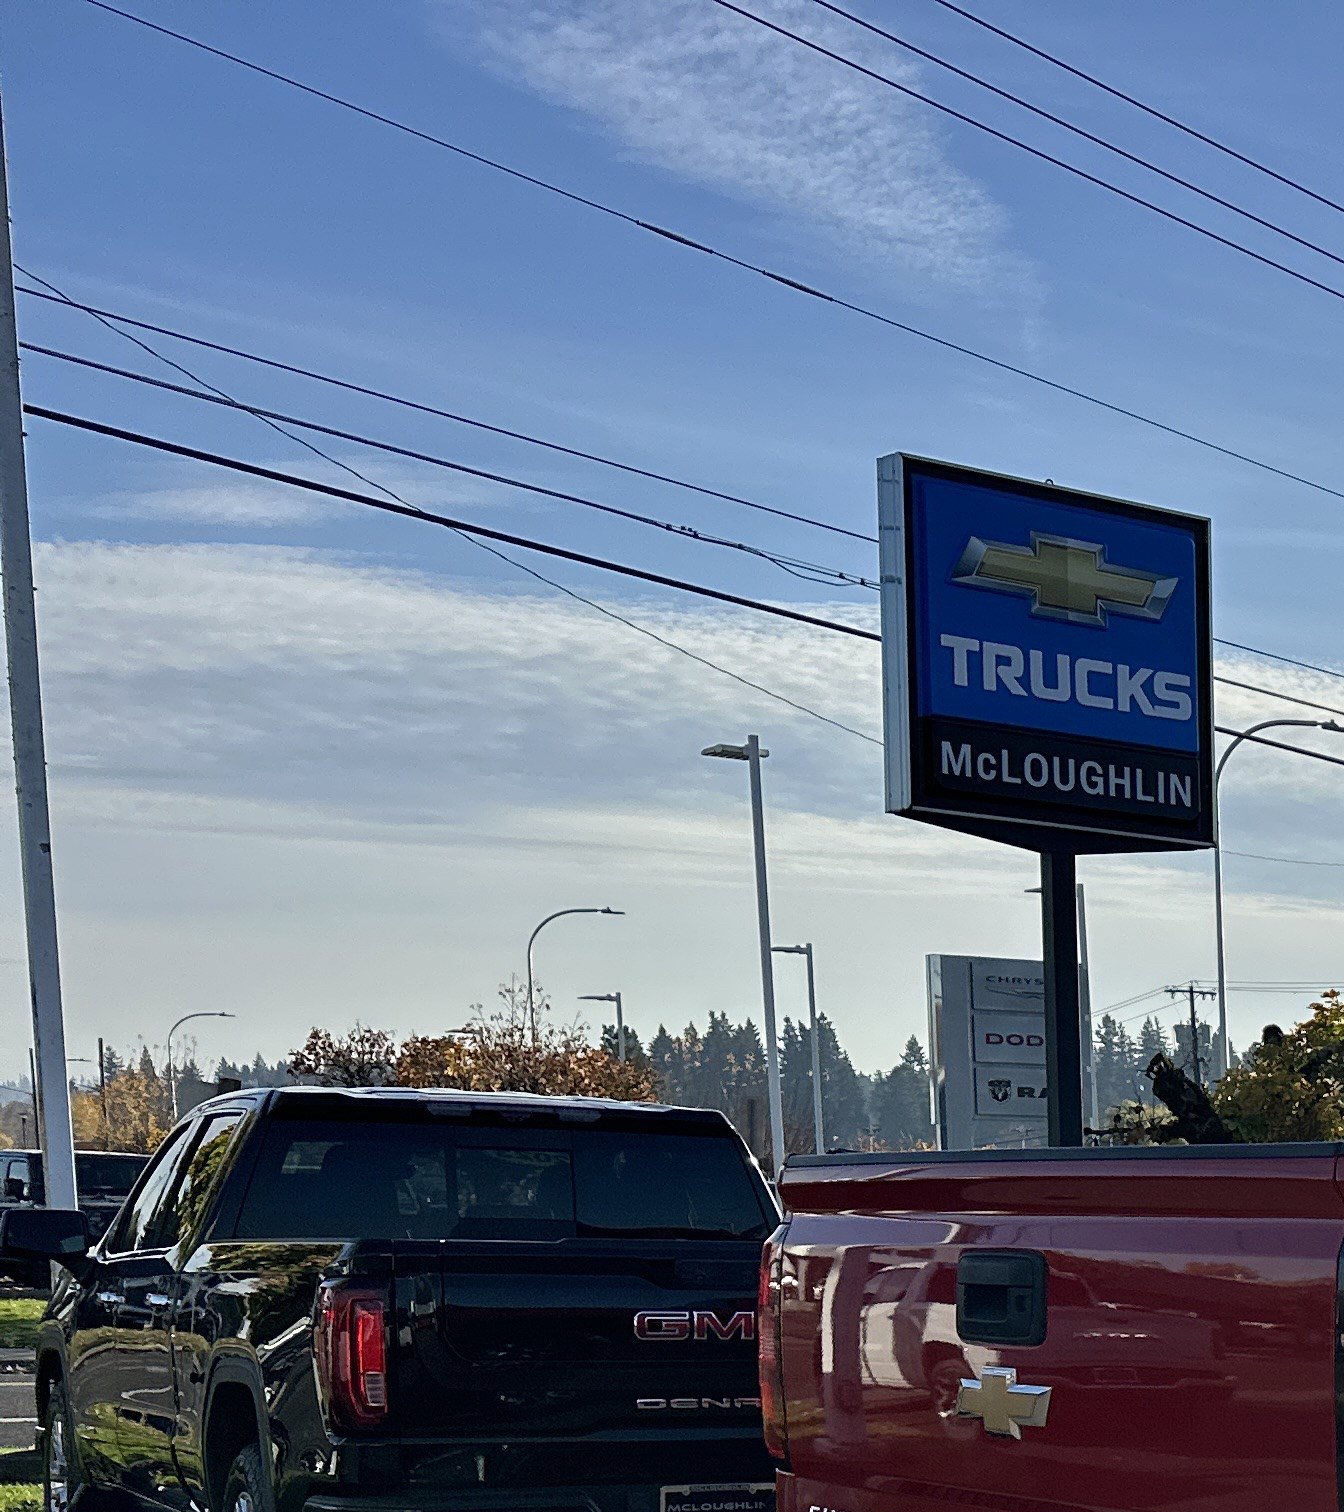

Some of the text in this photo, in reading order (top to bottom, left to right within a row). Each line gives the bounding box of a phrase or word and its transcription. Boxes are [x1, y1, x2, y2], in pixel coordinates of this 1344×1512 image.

[940, 633, 1192, 721] TRUCKS
[940, 740, 1192, 808] McLOUGHLIN
[985, 975, 1045, 986] CHRYS
[985, 1033, 1045, 1047] DOD
[1017, 1086, 1048, 1099] RA
[633, 1310, 756, 1341] GM
[636, 1397, 761, 1410] DENA
[667, 1501, 767, 1512] MCLOUGHLIN
